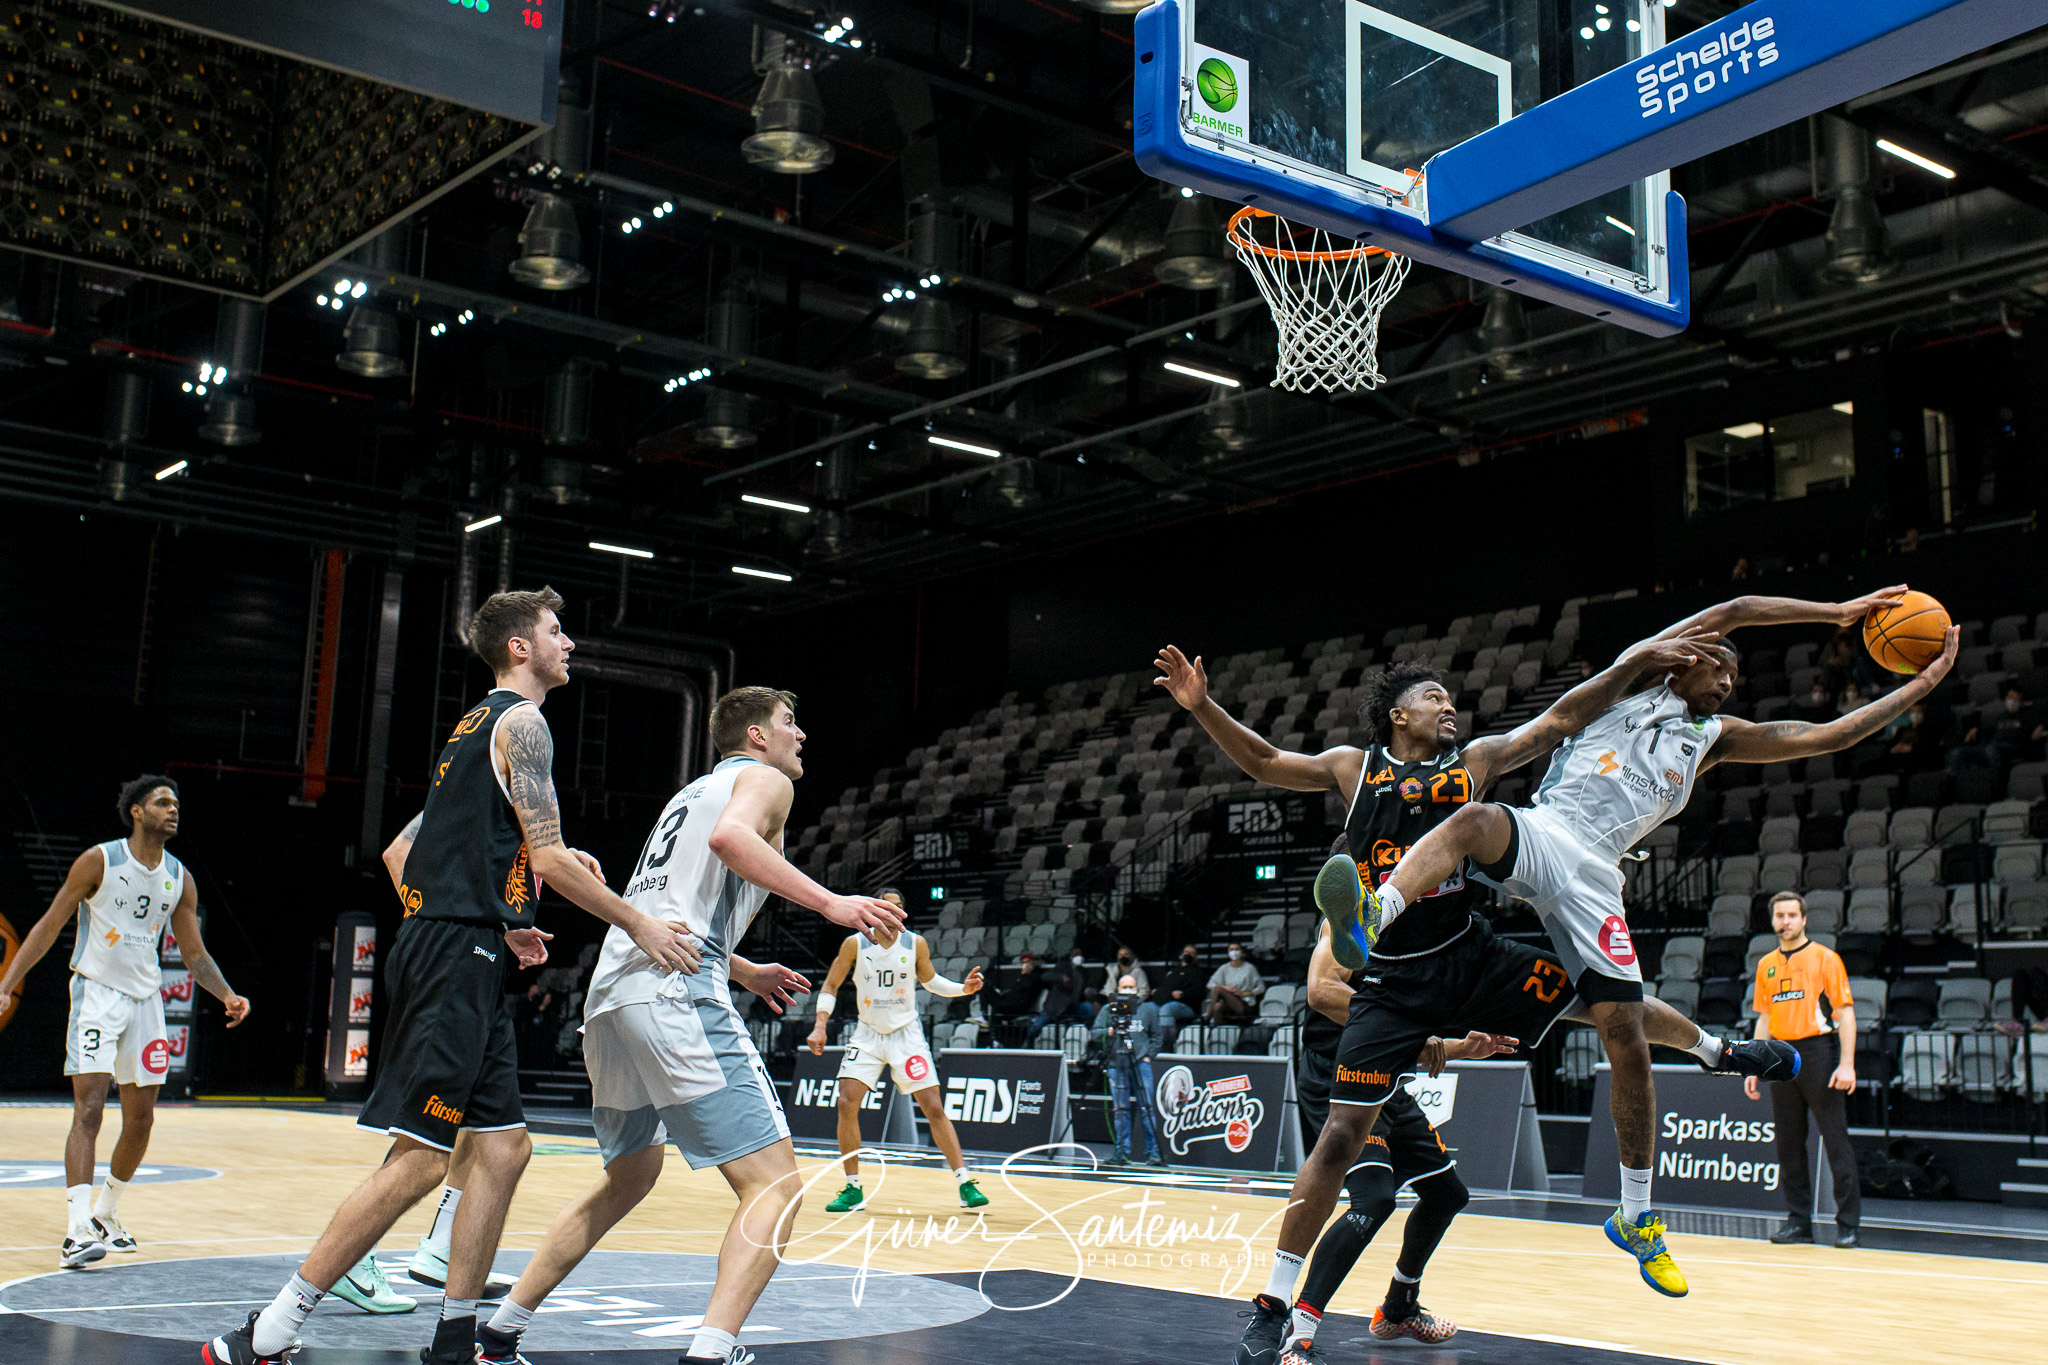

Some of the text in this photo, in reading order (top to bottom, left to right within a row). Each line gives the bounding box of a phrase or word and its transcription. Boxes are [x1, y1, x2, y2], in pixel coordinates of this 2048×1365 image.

[522, 9, 542, 29] 18
[1636, 17, 1775, 94] Schelde
[1640, 41, 1779, 118] Sports
[1193, 112, 1243, 138] BARMER
[1429, 768, 1468, 803] 23
[635, 805, 689, 877] 13
[133, 894, 151, 919] 3
[876, 969, 894, 988] 10
[1523, 959, 1568, 1003] 23
[84, 1028, 101, 1051] 3
[1336, 1064, 1391, 1087] fürstenberg
[944, 1077, 1012, 1124] EMS
[1166, 1089, 1250, 1136] Falcons
[1661, 1112, 1776, 1145] Sparkass
[1658, 1151, 1780, 1191] Nürnberg
